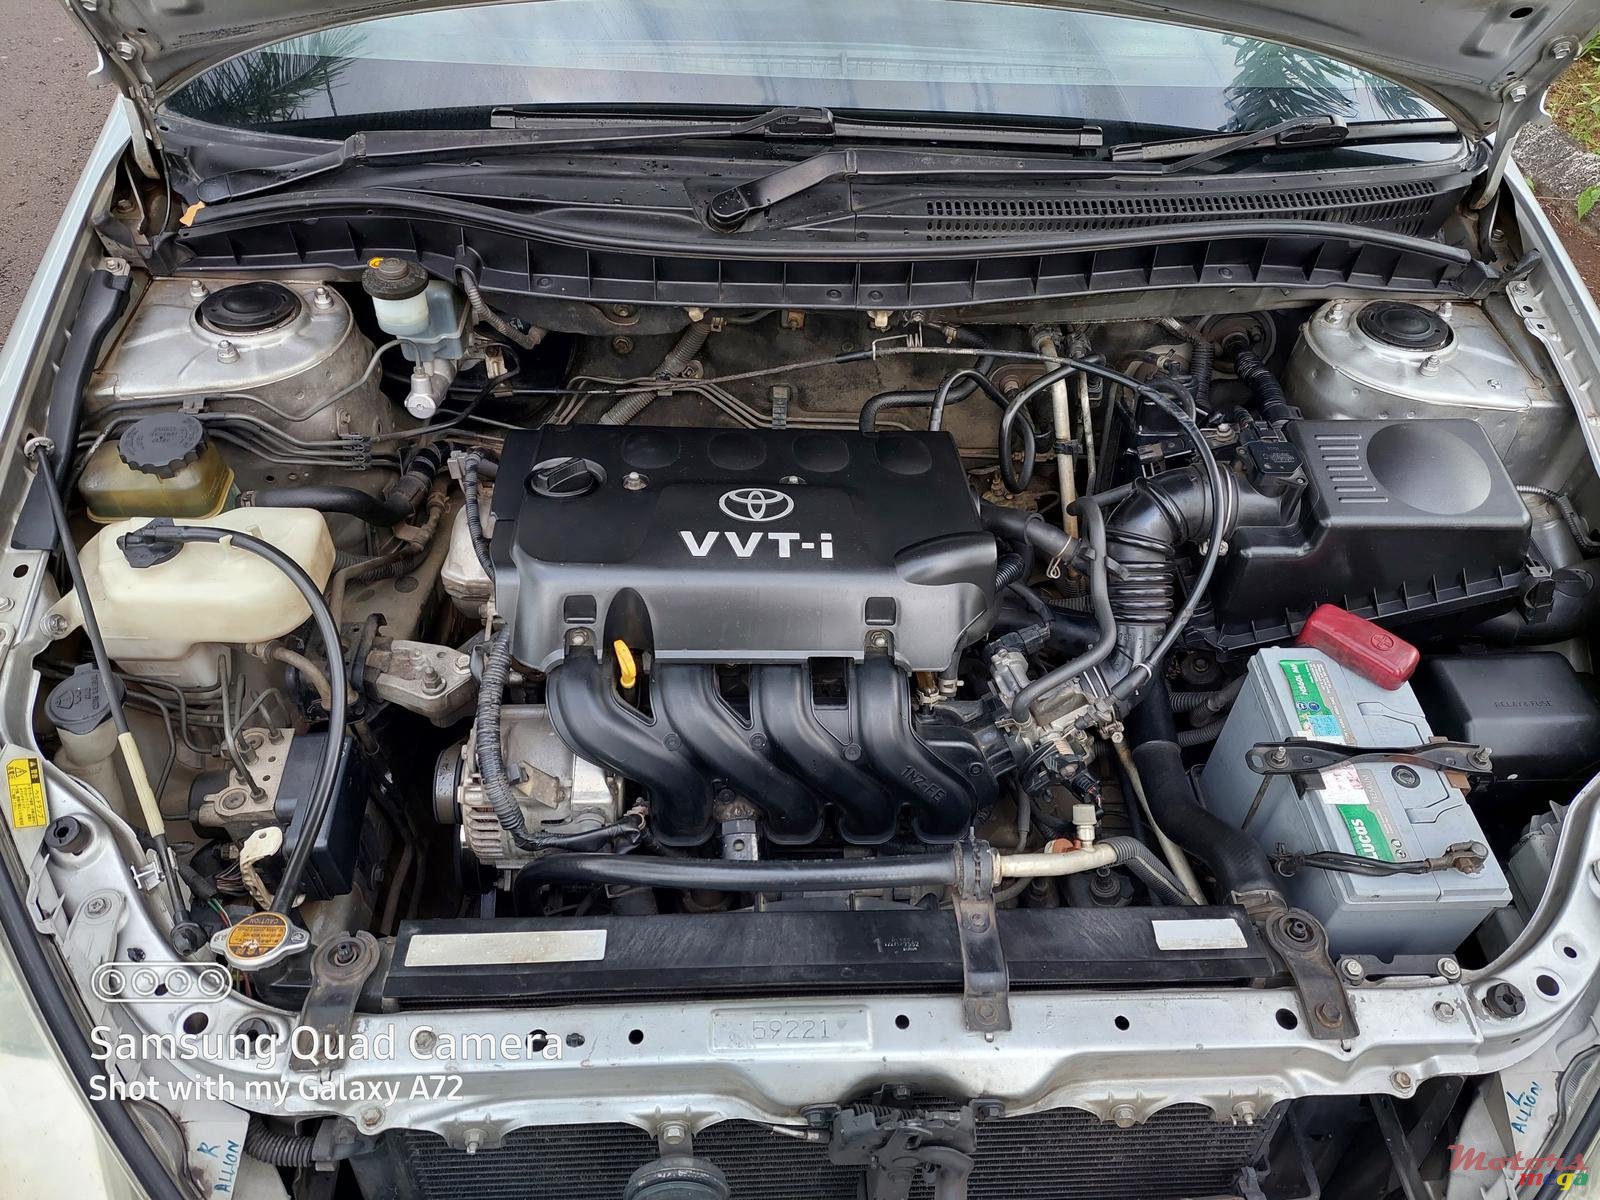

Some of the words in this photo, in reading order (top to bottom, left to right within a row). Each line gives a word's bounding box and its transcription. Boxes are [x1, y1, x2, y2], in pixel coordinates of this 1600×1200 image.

[680, 531, 833, 559] VVT-i
[249, 918, 279, 926] CAUTION
[752, 1019, 830, 1040] 59221
[1506, 1090, 1526, 1107] L
[1511, 1081, 1543, 1134] ALLION
[197, 1142, 221, 1158] R
[214, 1140, 241, 1193] ALLION
